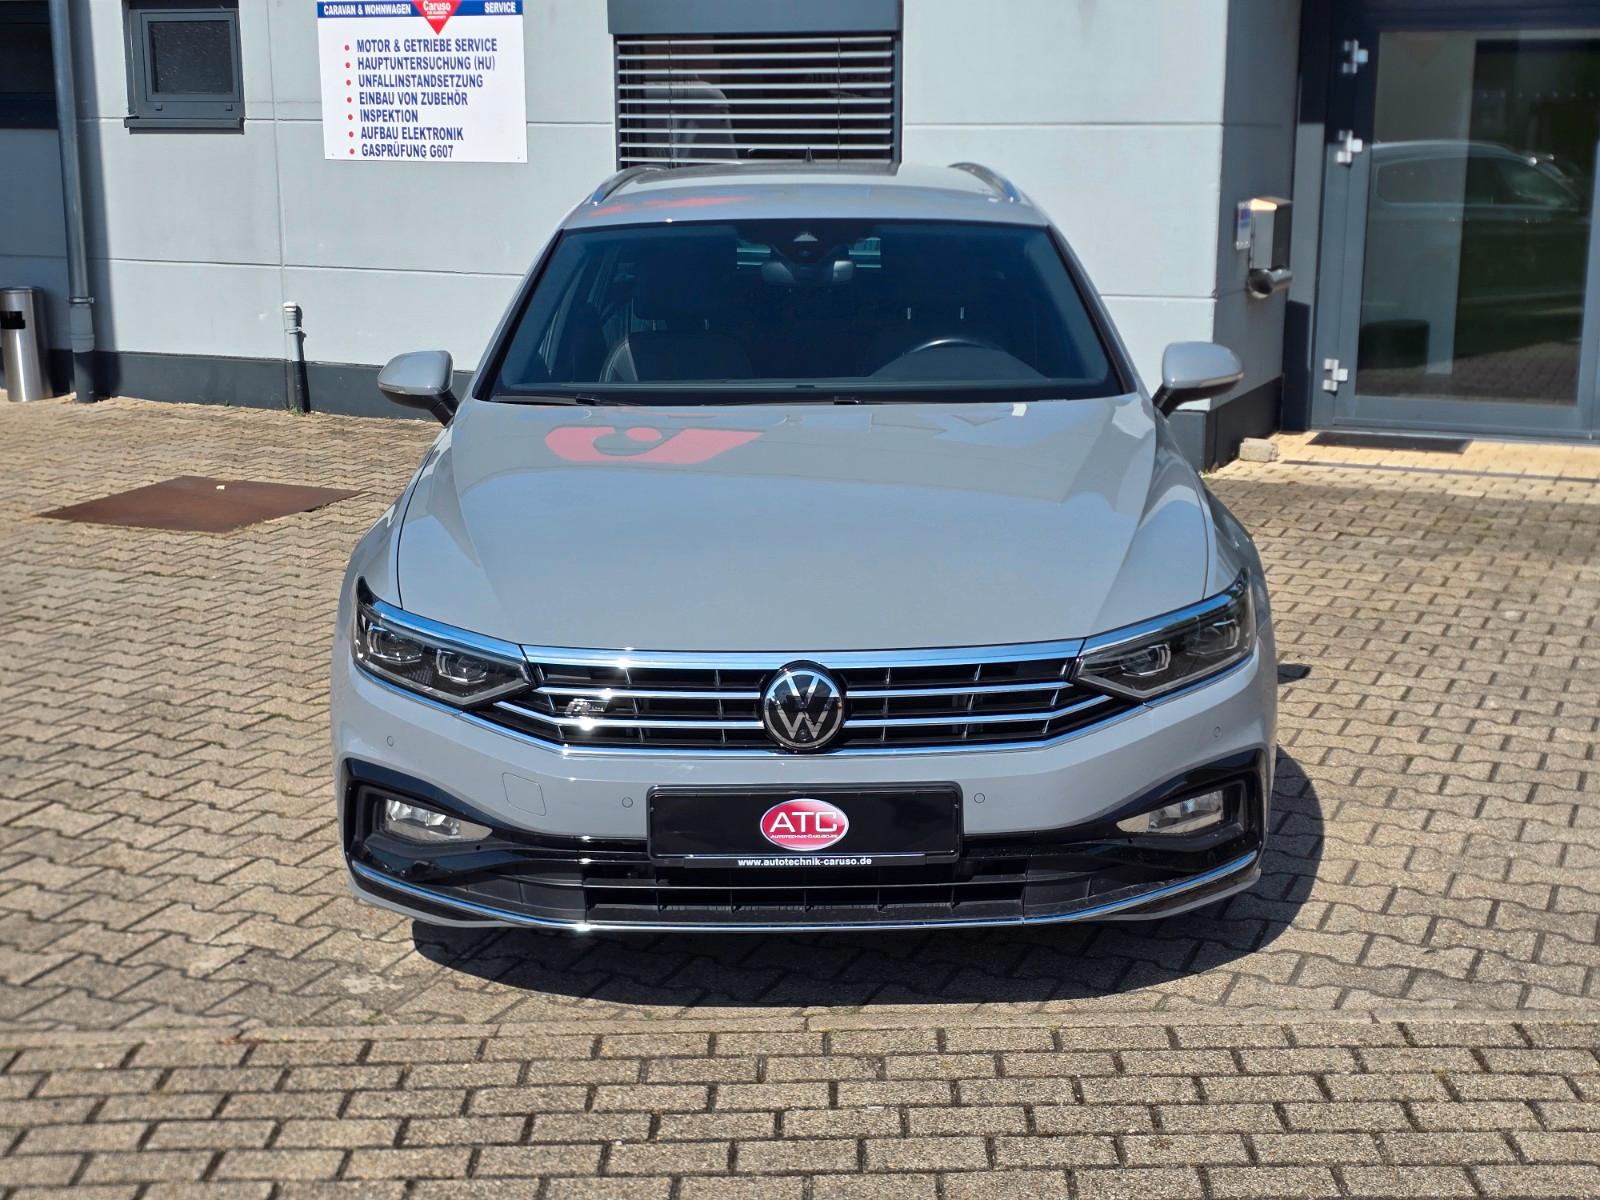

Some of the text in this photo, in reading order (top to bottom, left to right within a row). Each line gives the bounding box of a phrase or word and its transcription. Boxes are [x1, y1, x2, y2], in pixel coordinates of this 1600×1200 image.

[323, 3, 412, 16] CARAVAN & WOHNWAGEN
[422, 0, 452, 12] Caruso
[484, 2, 516, 14] SERVICE
[357, 38, 498, 53] MOTOR & GETRIEBE SERVICE
[357, 56, 496, 71] HAUPTUNTERSUCHUNG (HU)
[358, 74, 483, 88] UNFALLINSTANDSETZUNG
[359, 89, 468, 106] EINBAU VON ZUBEHÖR
[359, 109, 419, 123] INSPEKTION
[360, 127, 464, 141] AUFBAU ELEKTRONIK
[361, 142, 454, 158] GASPRÜFUNG G607
[769, 811, 838, 833] ATC
[737, 857, 873, 867] www.autotechnik-caruso.de
